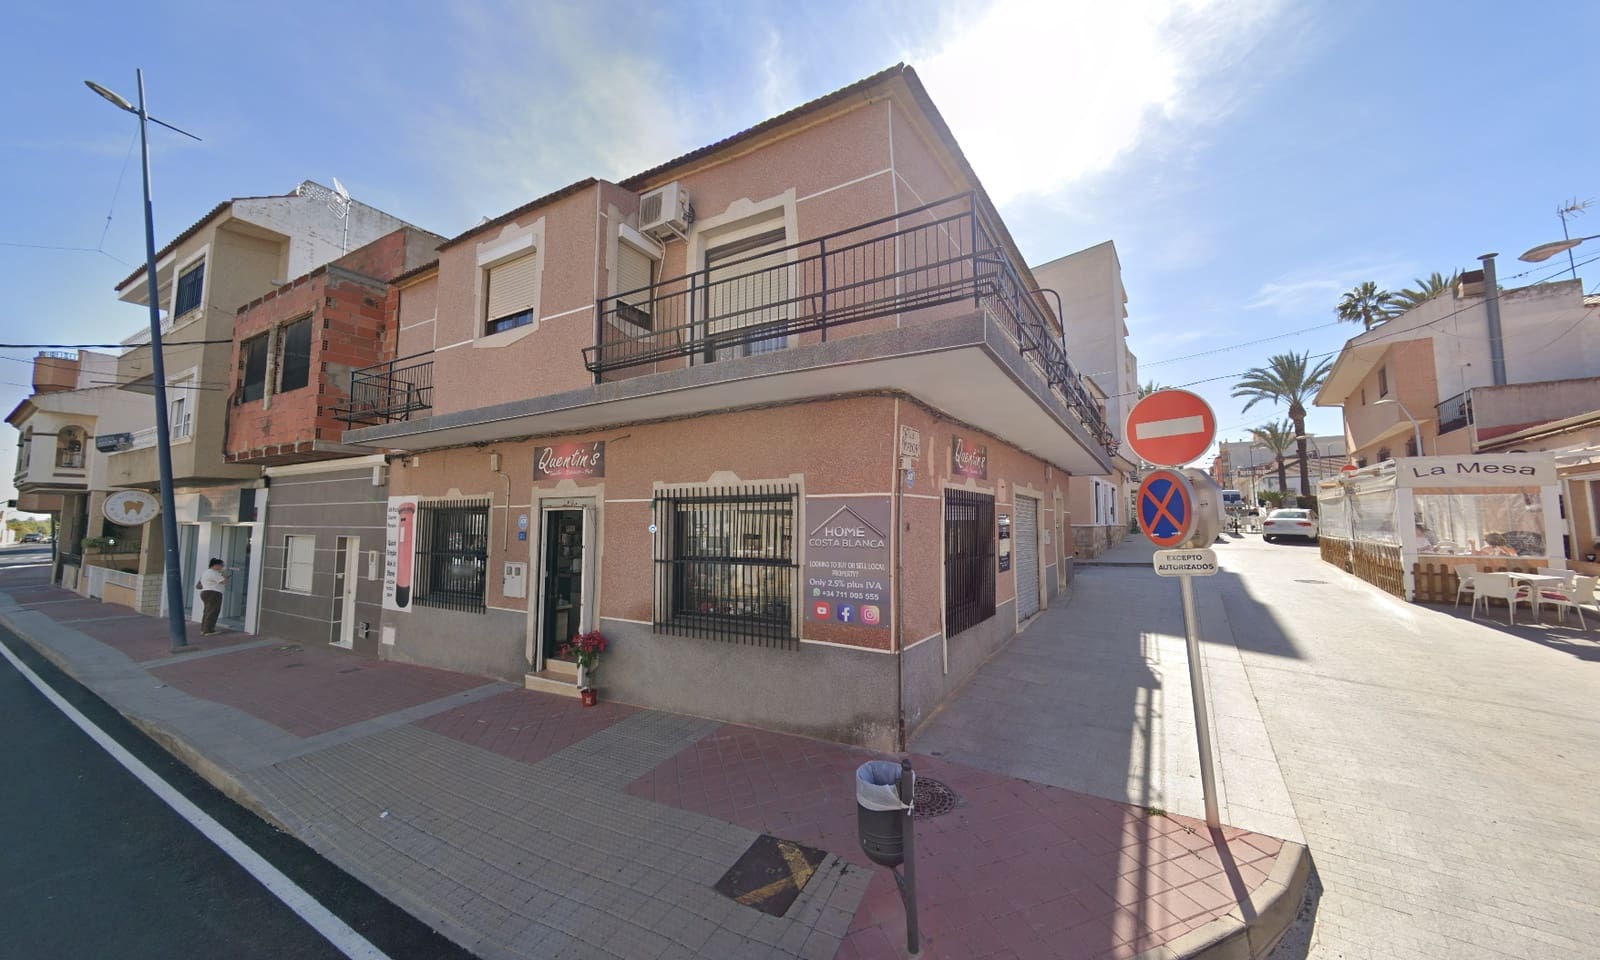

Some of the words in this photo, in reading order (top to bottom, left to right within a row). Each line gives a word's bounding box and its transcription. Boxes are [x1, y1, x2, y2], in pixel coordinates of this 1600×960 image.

[538, 442, 600, 474] Quentin's
[1412, 465, 1446, 478] La
[1456, 462, 1536, 476] Mesa
[825, 526, 865, 537] HOME
[809, 538, 840, 547] COSTA
[842, 539, 885, 548] BLANCA
[1158, 563, 1214, 571] AUTORIZADOS
[809, 578, 826, 587] Only
[828, 579, 845, 588] 2.5%
[846, 581, 864, 589] plus
[865, 581, 882, 590] IVA
[822, 590, 834, 598] +34
